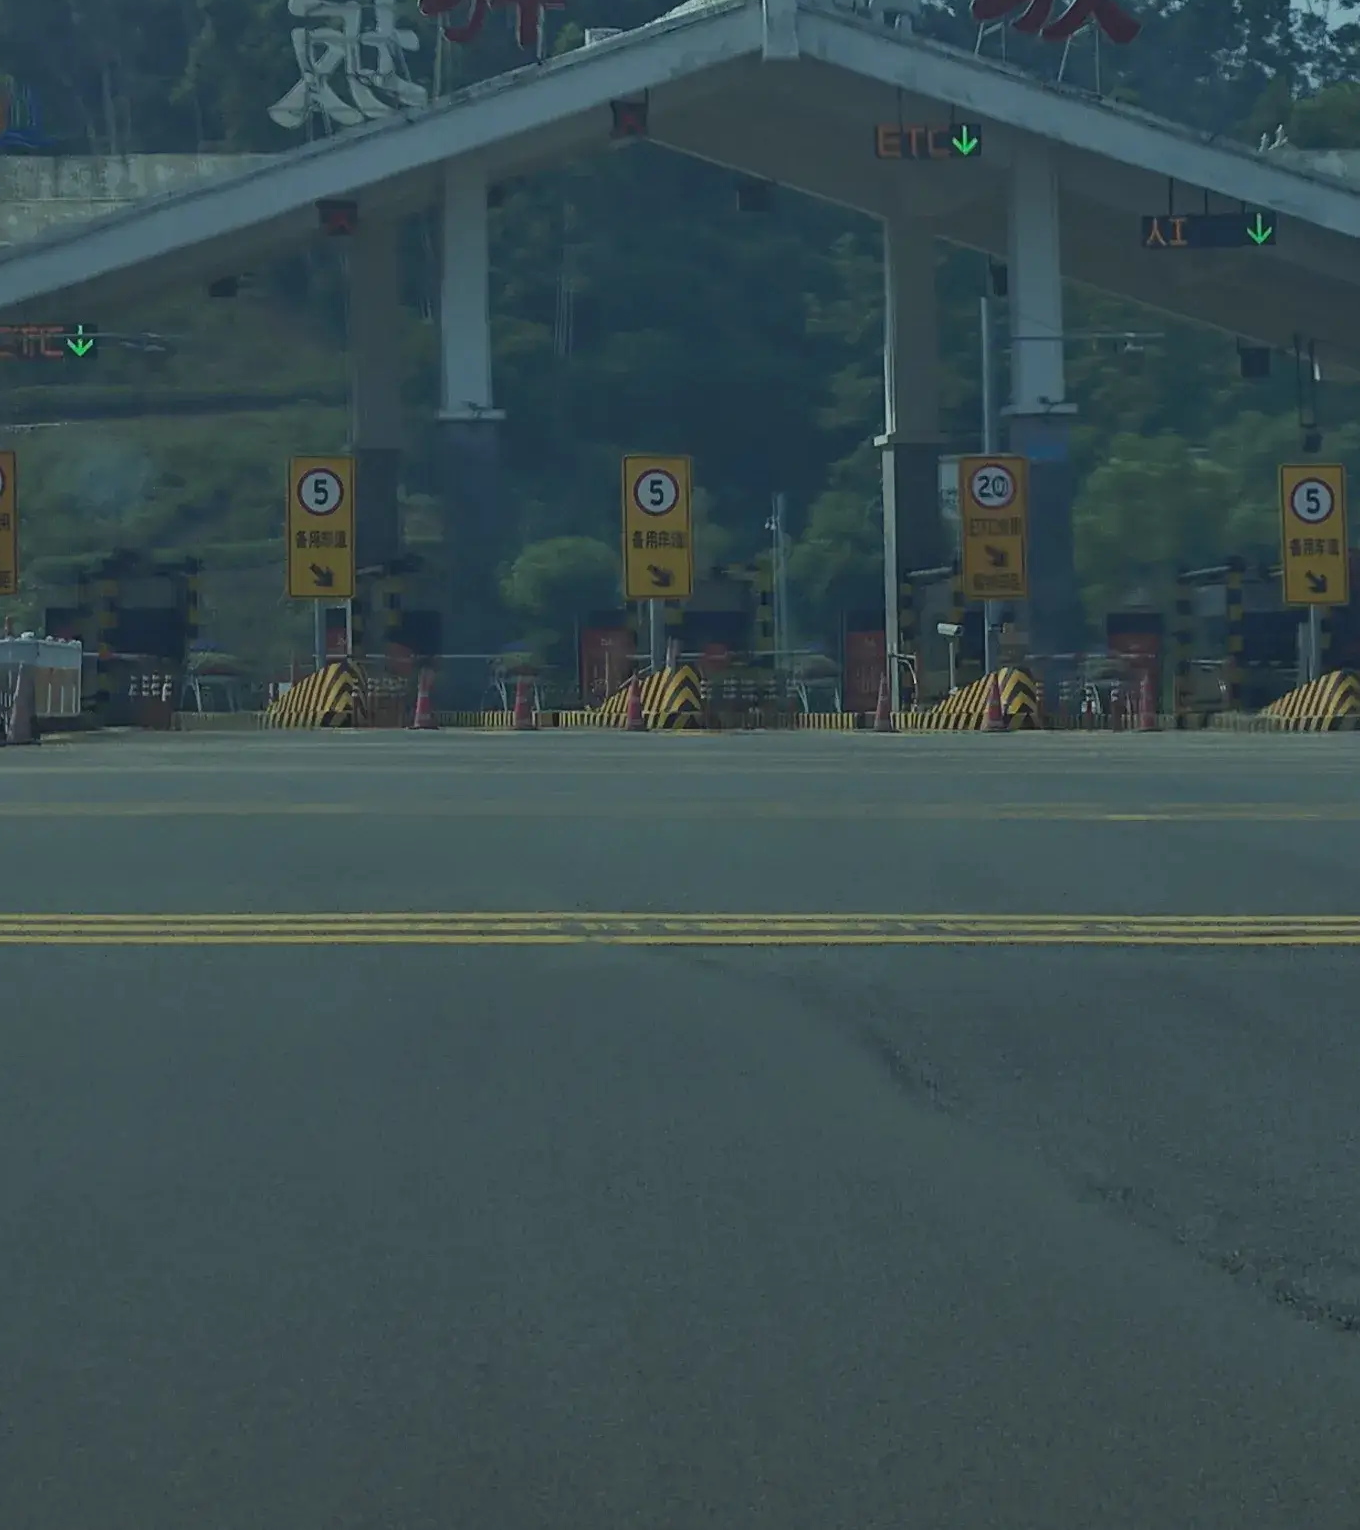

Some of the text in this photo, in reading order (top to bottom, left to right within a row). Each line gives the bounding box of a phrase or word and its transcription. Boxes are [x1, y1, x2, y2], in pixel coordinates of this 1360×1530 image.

[877, 125, 949, 158] ETC
[1145, 217, 1189, 246] 人工
[313, 479, 329, 505] 5
[649, 479, 665, 506] 5
[977, 475, 1008, 498] 20
[1305, 488, 1321, 514] 5
